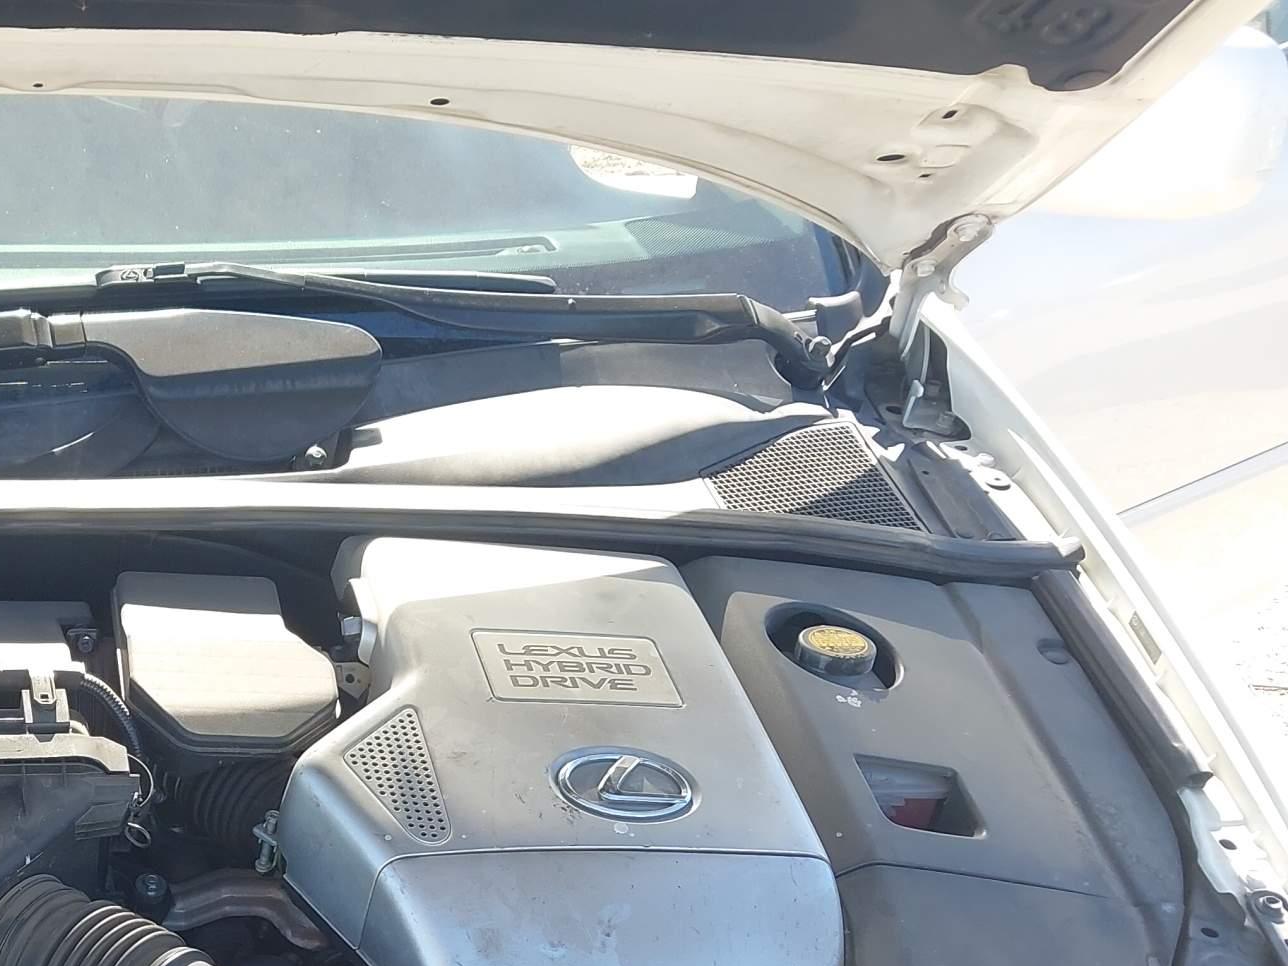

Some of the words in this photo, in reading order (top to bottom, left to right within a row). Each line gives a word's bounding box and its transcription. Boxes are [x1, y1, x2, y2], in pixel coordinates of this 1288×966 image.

[497, 643, 637, 660] LEXUS
[503, 659, 652, 676] HYBRID
[509, 674, 637, 691] DRIVE
